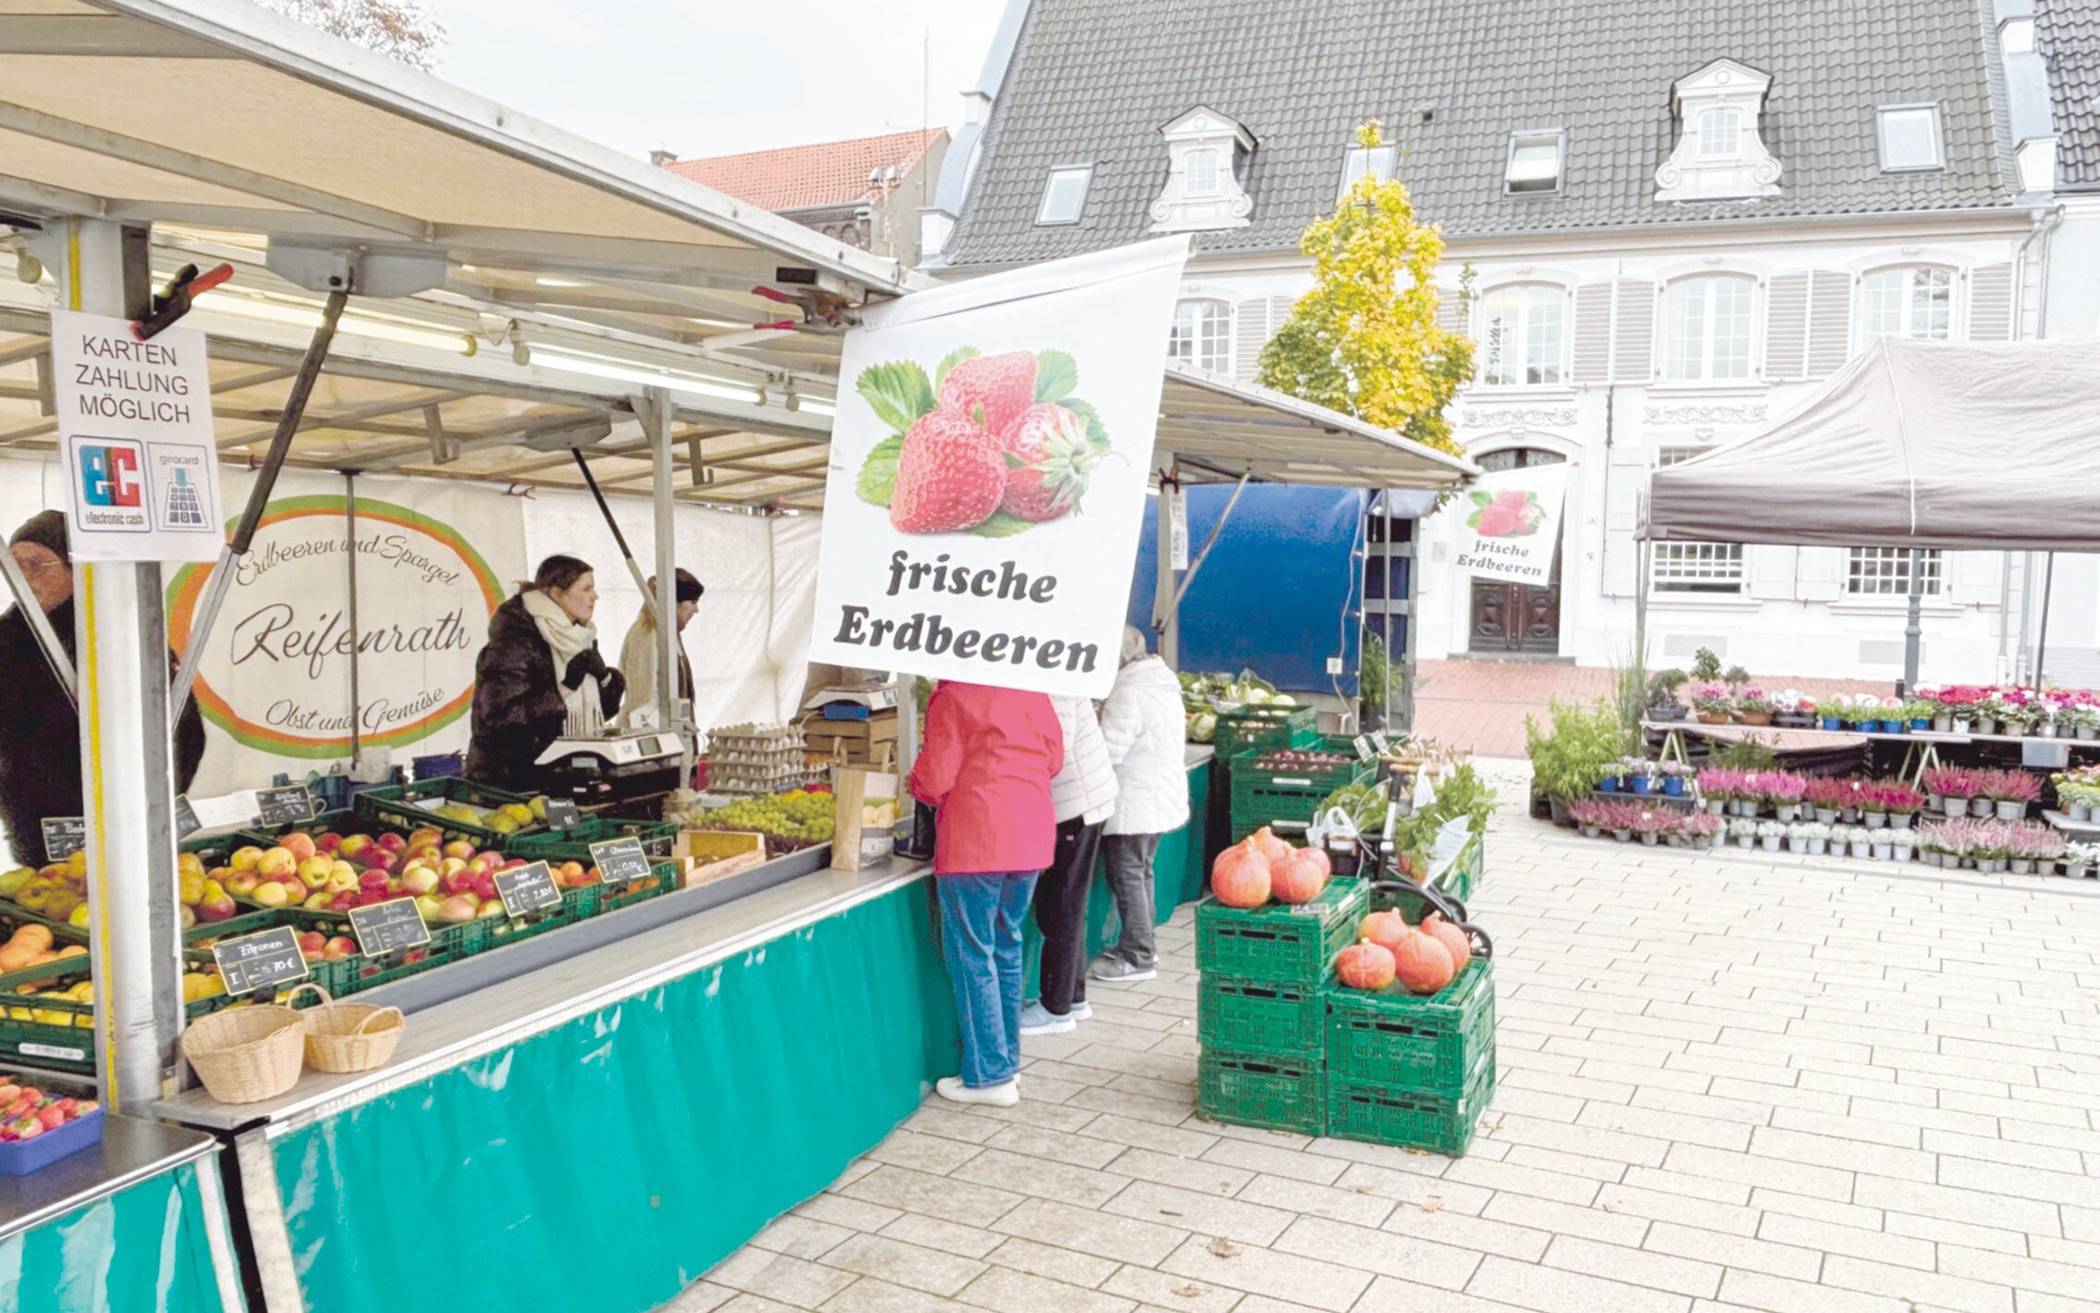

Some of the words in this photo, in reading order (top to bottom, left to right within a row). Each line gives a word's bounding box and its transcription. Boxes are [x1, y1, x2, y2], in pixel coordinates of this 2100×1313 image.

[82, 335, 177, 366] KARTEN
[75, 364, 189, 395] ZAHLUNG
[79, 393, 191, 423] MÖGLICH
[236, 540, 337, 586] Erdbeeren
[340, 534, 381, 554] und
[381, 534, 460, 586] Spargel
[1457, 553, 1542, 577] Erdbeeren
[1474, 539, 1530, 558] frische
[886, 549, 1058, 604] frische
[231, 603, 471, 680] Reifenrath
[833, 604, 1099, 673] Erdbeeren
[265, 698, 318, 730] Obst
[362, 688, 445, 735] Gemüse
